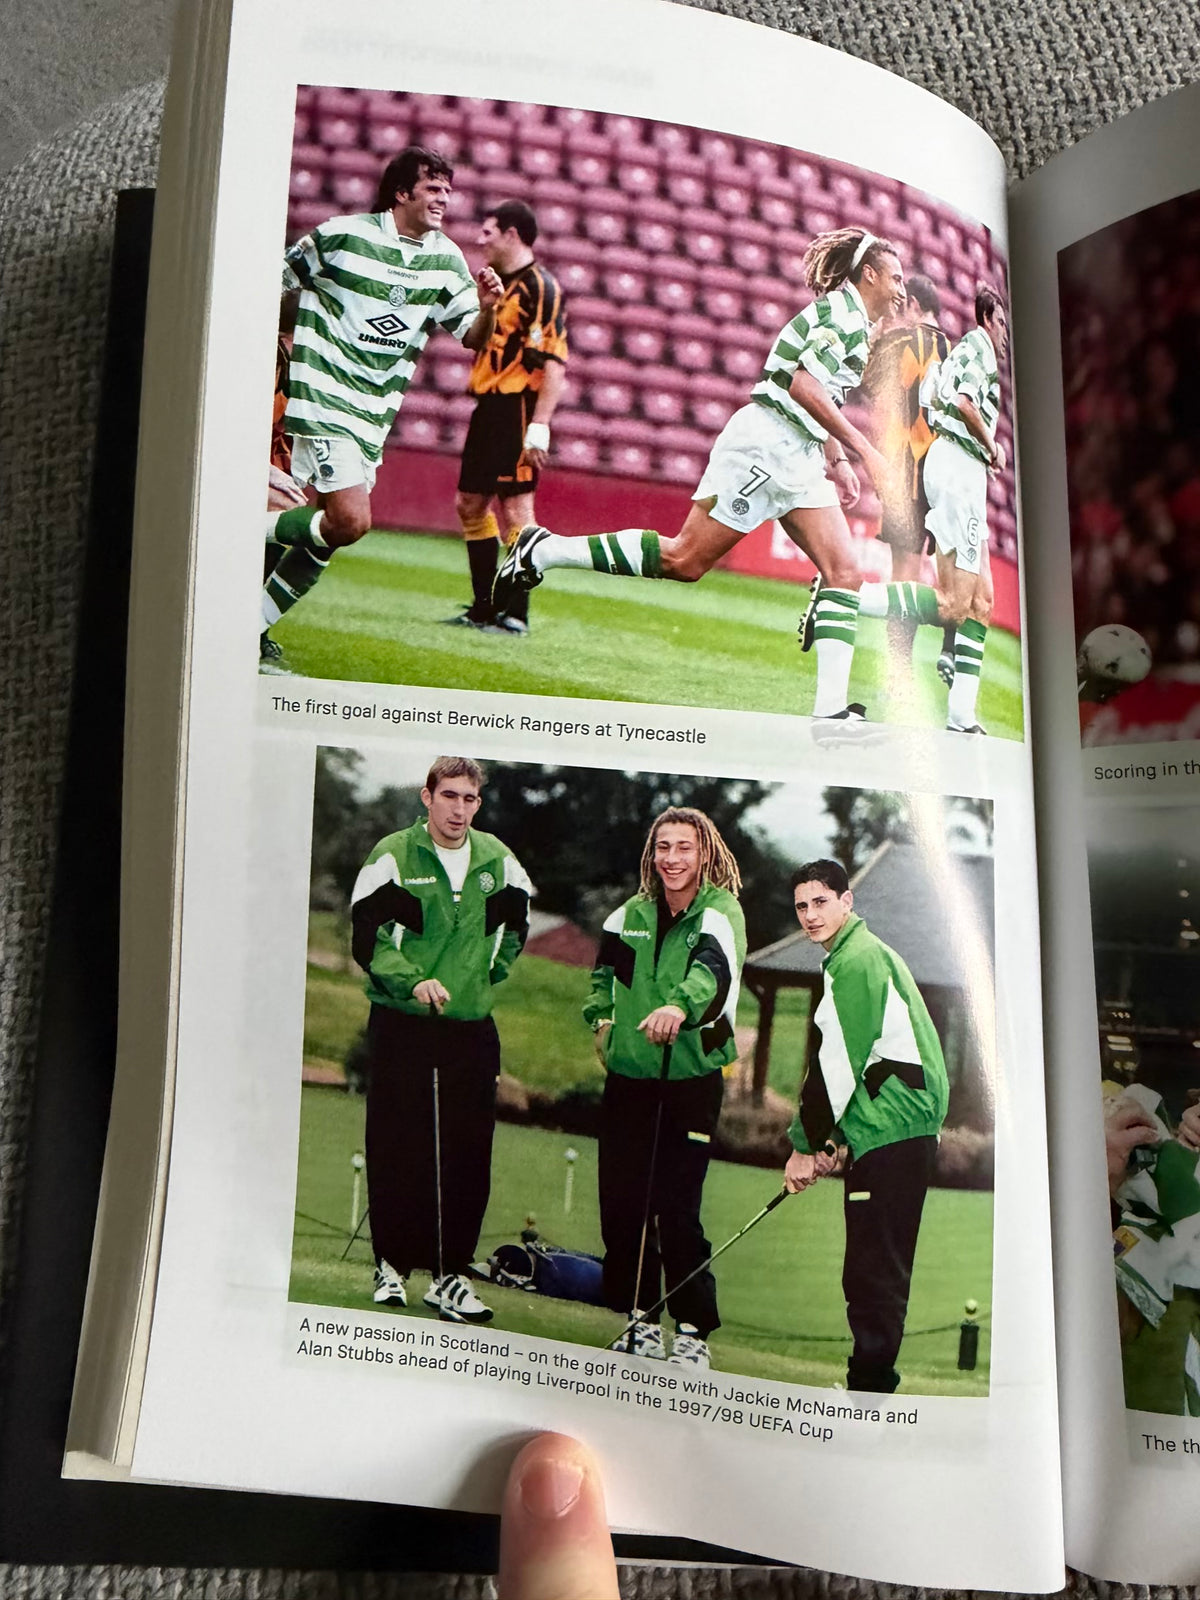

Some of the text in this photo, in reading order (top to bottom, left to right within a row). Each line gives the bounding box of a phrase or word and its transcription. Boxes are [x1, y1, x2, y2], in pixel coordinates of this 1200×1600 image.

[358, 333, 407, 349] UMBRO
[738, 465, 771, 498] 7
[272, 696, 706, 745] The first goal against Berwick Rangers at Tynecastle
[1094, 764, 1156, 780] Scoring
[1162, 762, 1178, 776] in
[300, 1318, 310, 1332] A
[316, 1321, 349, 1336] new
[353, 1325, 415, 1344] passion
[421, 1331, 435, 1347] in
[440, 1334, 510, 1358] Scotland
[528, 1351, 548, 1365] on
[554, 1353, 579, 1370] the
[584, 1361, 617, 1377] golf
[621, 1367, 677, 1390] course
[683, 1380, 719, 1398] with
[723, 1386, 780, 1409] Jackie
[786, 1397, 881, 1423] McNamara
[886, 1408, 918, 1425] and
[297, 1340, 833, 1443] Alan Stubbs ahead of playing Liverpool in the 1997/98 UEFA Cup
[1141, 1434, 1200, 1454] The th
